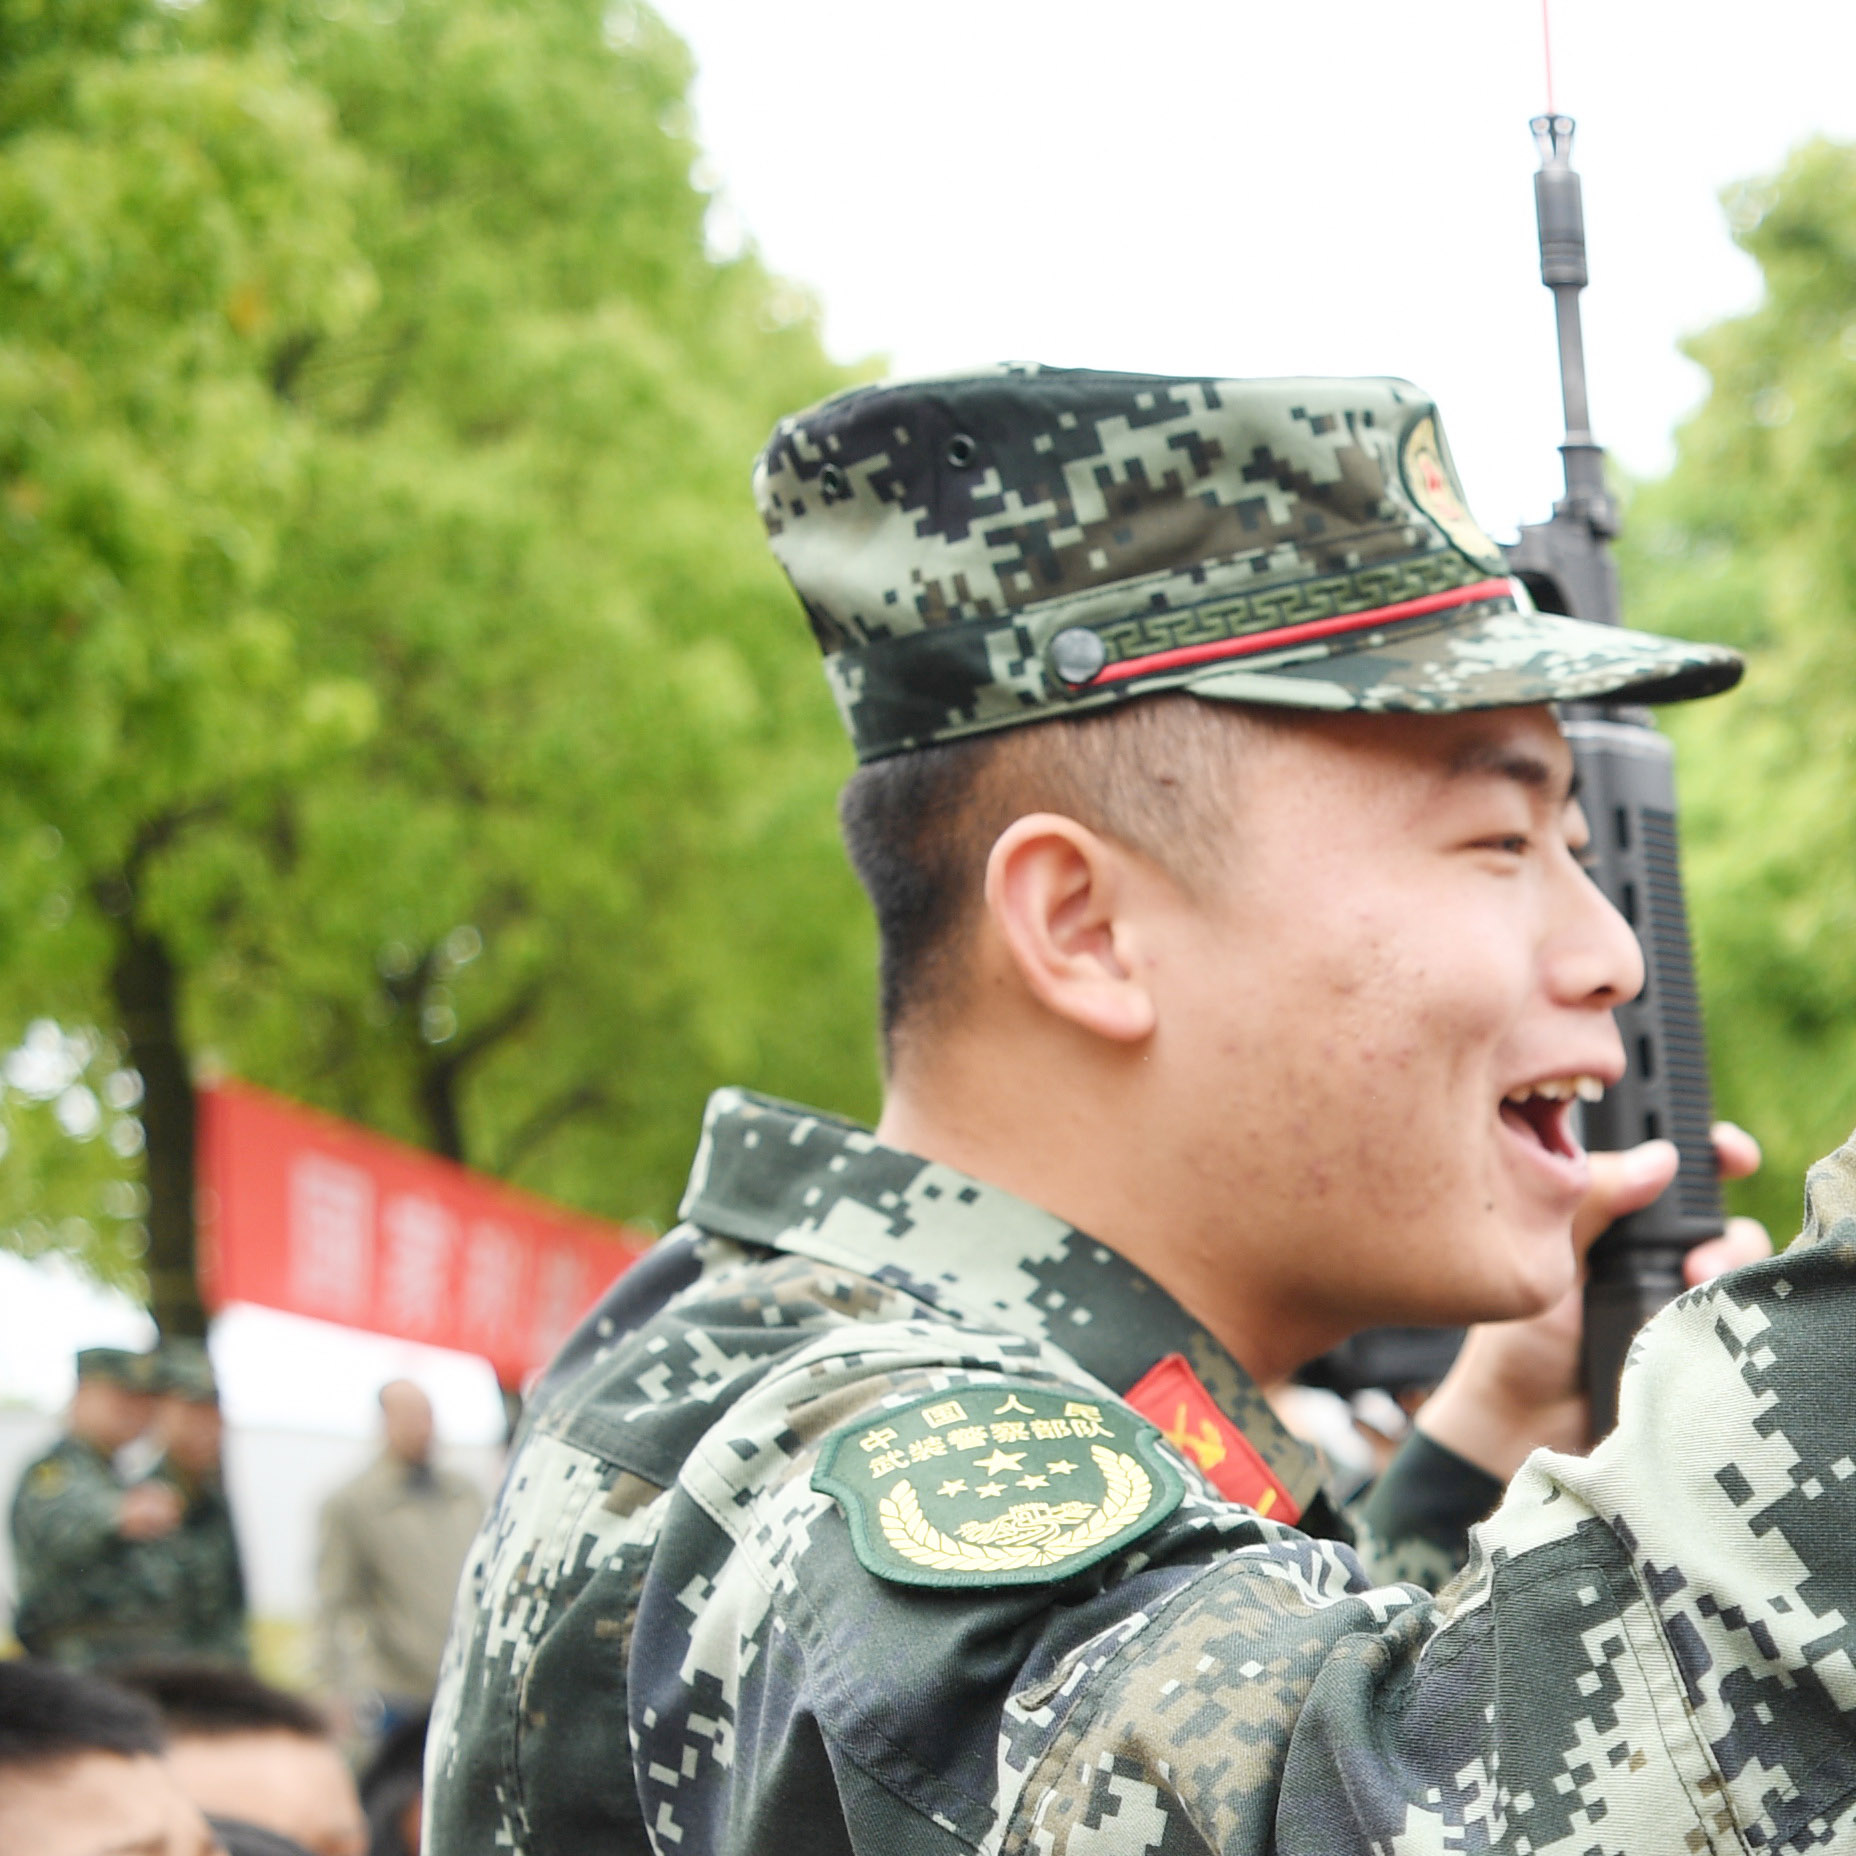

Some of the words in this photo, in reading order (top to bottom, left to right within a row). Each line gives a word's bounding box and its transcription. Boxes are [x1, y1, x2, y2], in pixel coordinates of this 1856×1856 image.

[859, 1394, 1104, 1452] 中国人民
[868, 1418, 1115, 1479] 武装警察部队
